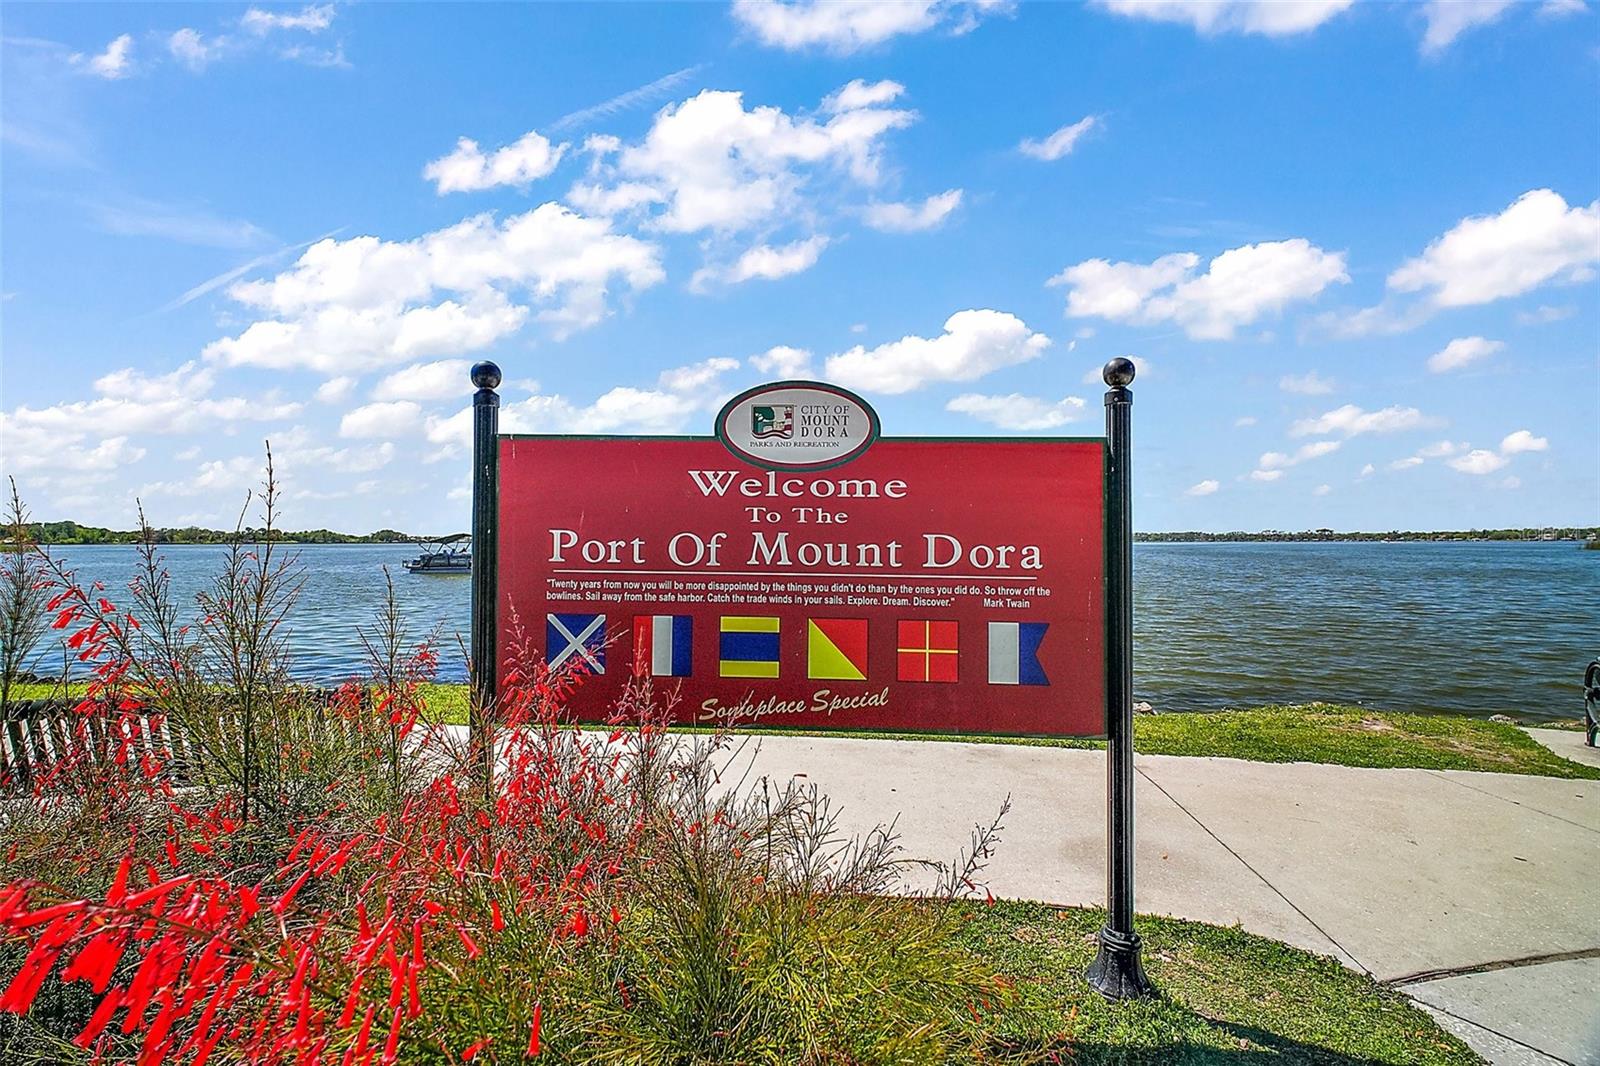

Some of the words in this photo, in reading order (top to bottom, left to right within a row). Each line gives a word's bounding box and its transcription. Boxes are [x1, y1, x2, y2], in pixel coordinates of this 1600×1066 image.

[801, 405, 831, 414] CITY
[833, 405, 850, 414] OF
[801, 415, 850, 426] MOUNT
[801, 427, 849, 437] DORA
[687, 470, 907, 498] Welcome
[744, 507, 781, 523] To
[791, 507, 848, 524] The
[548, 529, 646, 564] Port
[668, 532, 727, 567] Of
[746, 532, 903, 568] Mount
[922, 534, 1044, 570] Dora
[580, 581, 601, 591] years
[603, 580, 622, 589] from
[624, 581, 640, 589] now
[641, 582, 657, 591] you
[658, 580, 672, 590] will
[673, 581, 684, 590] be
[685, 582, 706, 590] more
[707, 581, 759, 592] disappointed
[760, 582, 771, 592] by
[772, 582, 785, 591] the
[787, 582, 812, 593] things
[813, 584, 829, 593] you
[831, 583, 854, 592] didn't
[855, 583, 866, 592] do
[867, 583, 886, 593] than
[887, 584, 898, 595] by
[900, 584, 913, 593] the
[914, 586, 935, 594] ones
[936, 586, 953, 596] you
[954, 585, 968, 594] did
[969, 585, 983, 595] do.
[984, 585, 996, 595] So
[997, 586, 1022, 595] throw
[1023, 586, 1036, 596] off
[1036, 586, 1051, 596] the
[546, 591, 584, 600] bowlines.
[585, 591, 600, 600] Sail
[601, 592, 622, 603] away
[623, 591, 643, 601] from
[644, 592, 657, 601] the
[658, 592, 676, 602] safe
[677, 592, 706, 602] harbor.
[707, 593, 731, 603] Catch
[732, 593, 745, 603] the
[746, 594, 767, 603] trade
[768, 594, 793, 604] winds
[794, 594, 802, 604] in
[803, 595, 823, 606] your
[824, 595, 846, 605] sails.
[847, 596, 881, 606] Explore.
[882, 596, 911, 606] Dream.
[983, 598, 1004, 608] Mark
[1006, 598, 1030, 608] Twain
[699, 695, 807, 722] Someplace
[811, 687, 889, 716] Special
